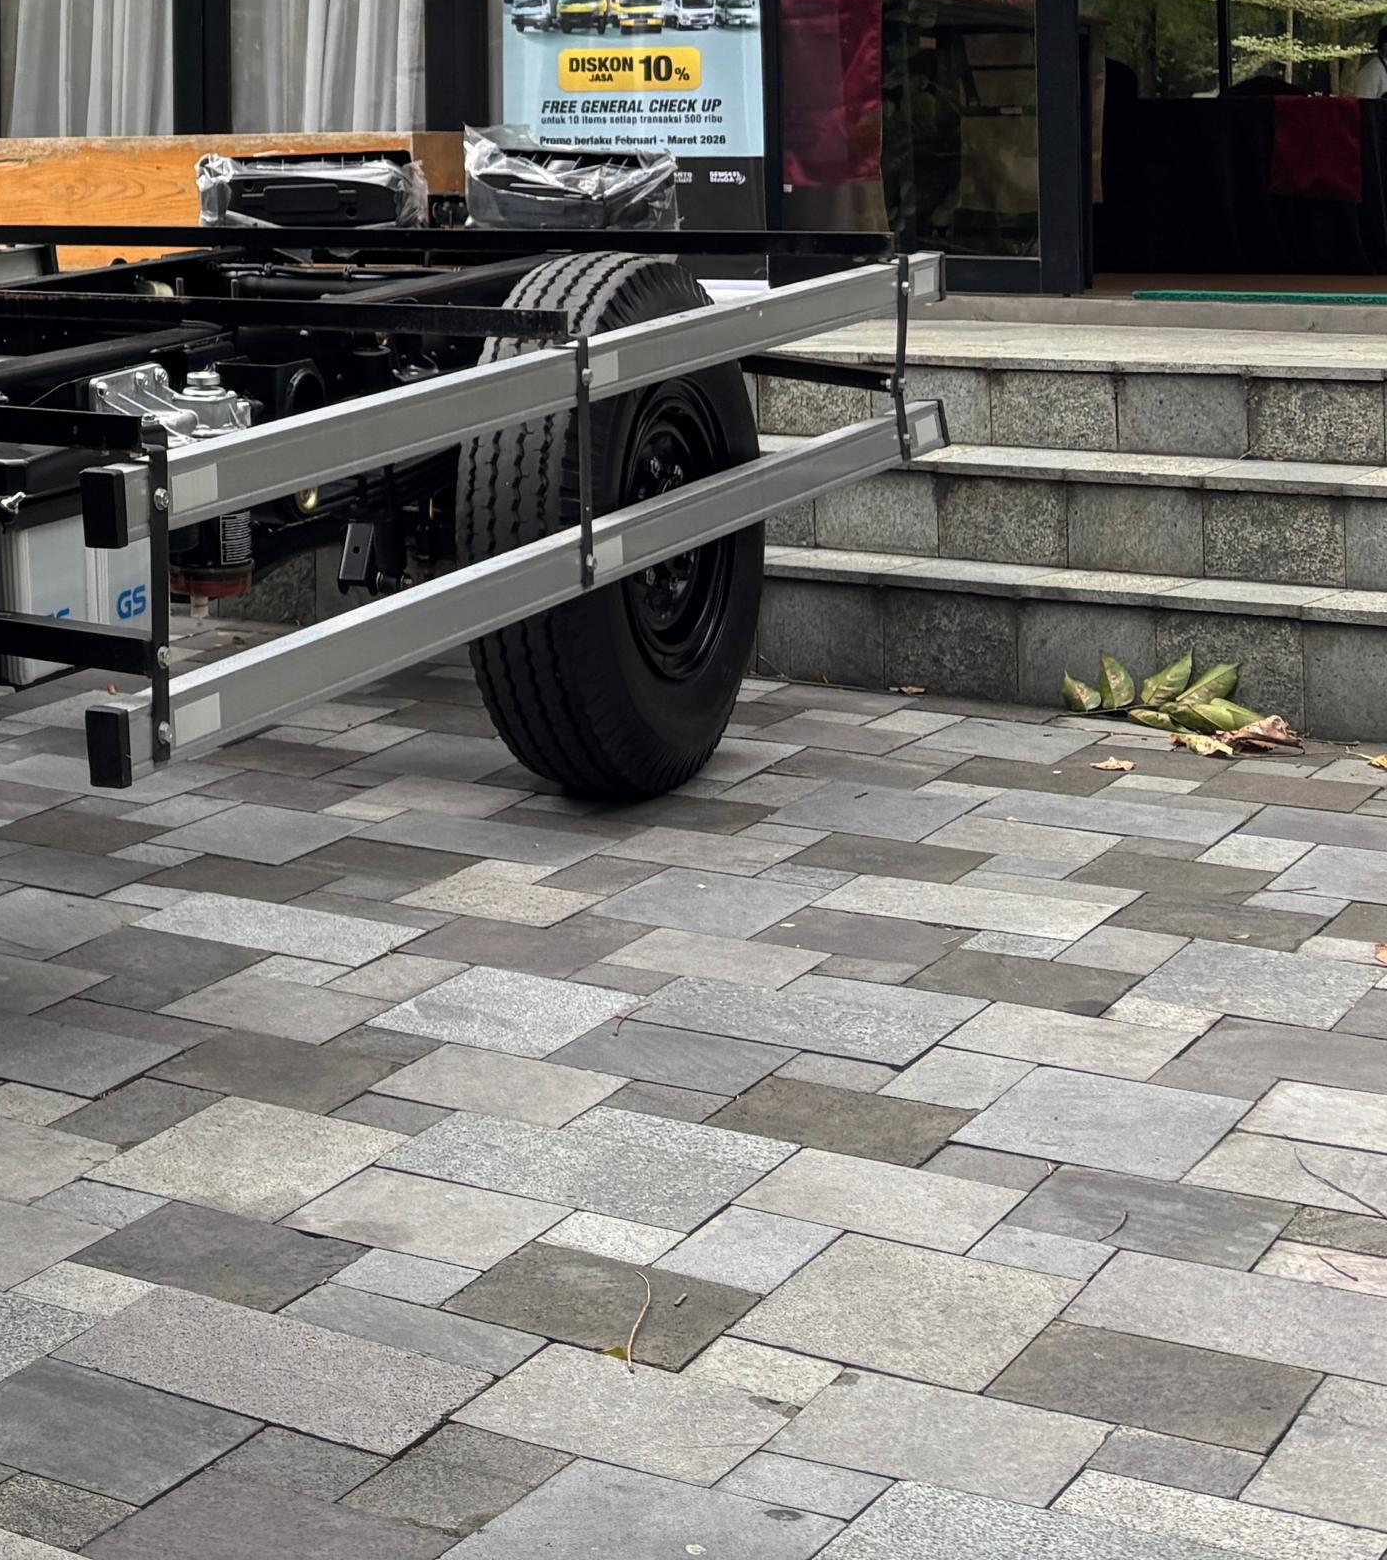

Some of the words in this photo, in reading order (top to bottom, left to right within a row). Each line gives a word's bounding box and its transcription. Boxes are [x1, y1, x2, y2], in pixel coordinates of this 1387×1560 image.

[568, 56, 634, 72] DISKON
[639, 55, 690, 81] 10%
[589, 74, 613, 82] JASA
[541, 100, 578, 114] FREE
[581, 99, 643, 113] GENERAL
[649, 99, 697, 113] CHECK
[701, 98, 722, 112] UP
[541, 115, 565, 124] untuk
[568, 115, 579, 124] 10
[582, 115, 607, 124] items
[609, 115, 637, 126] setiap
[640, 115, 681, 124] transaksi
[684, 114, 702, 123] 500
[704, 114, 723, 123] ribu
[539, 136, 572, 145] Promo
[574, 136, 612, 145] berlaku
[615, 136, 657, 144] Februari
[667, 135, 698, 144] Maret
[116, 584, 147, 620] GS
